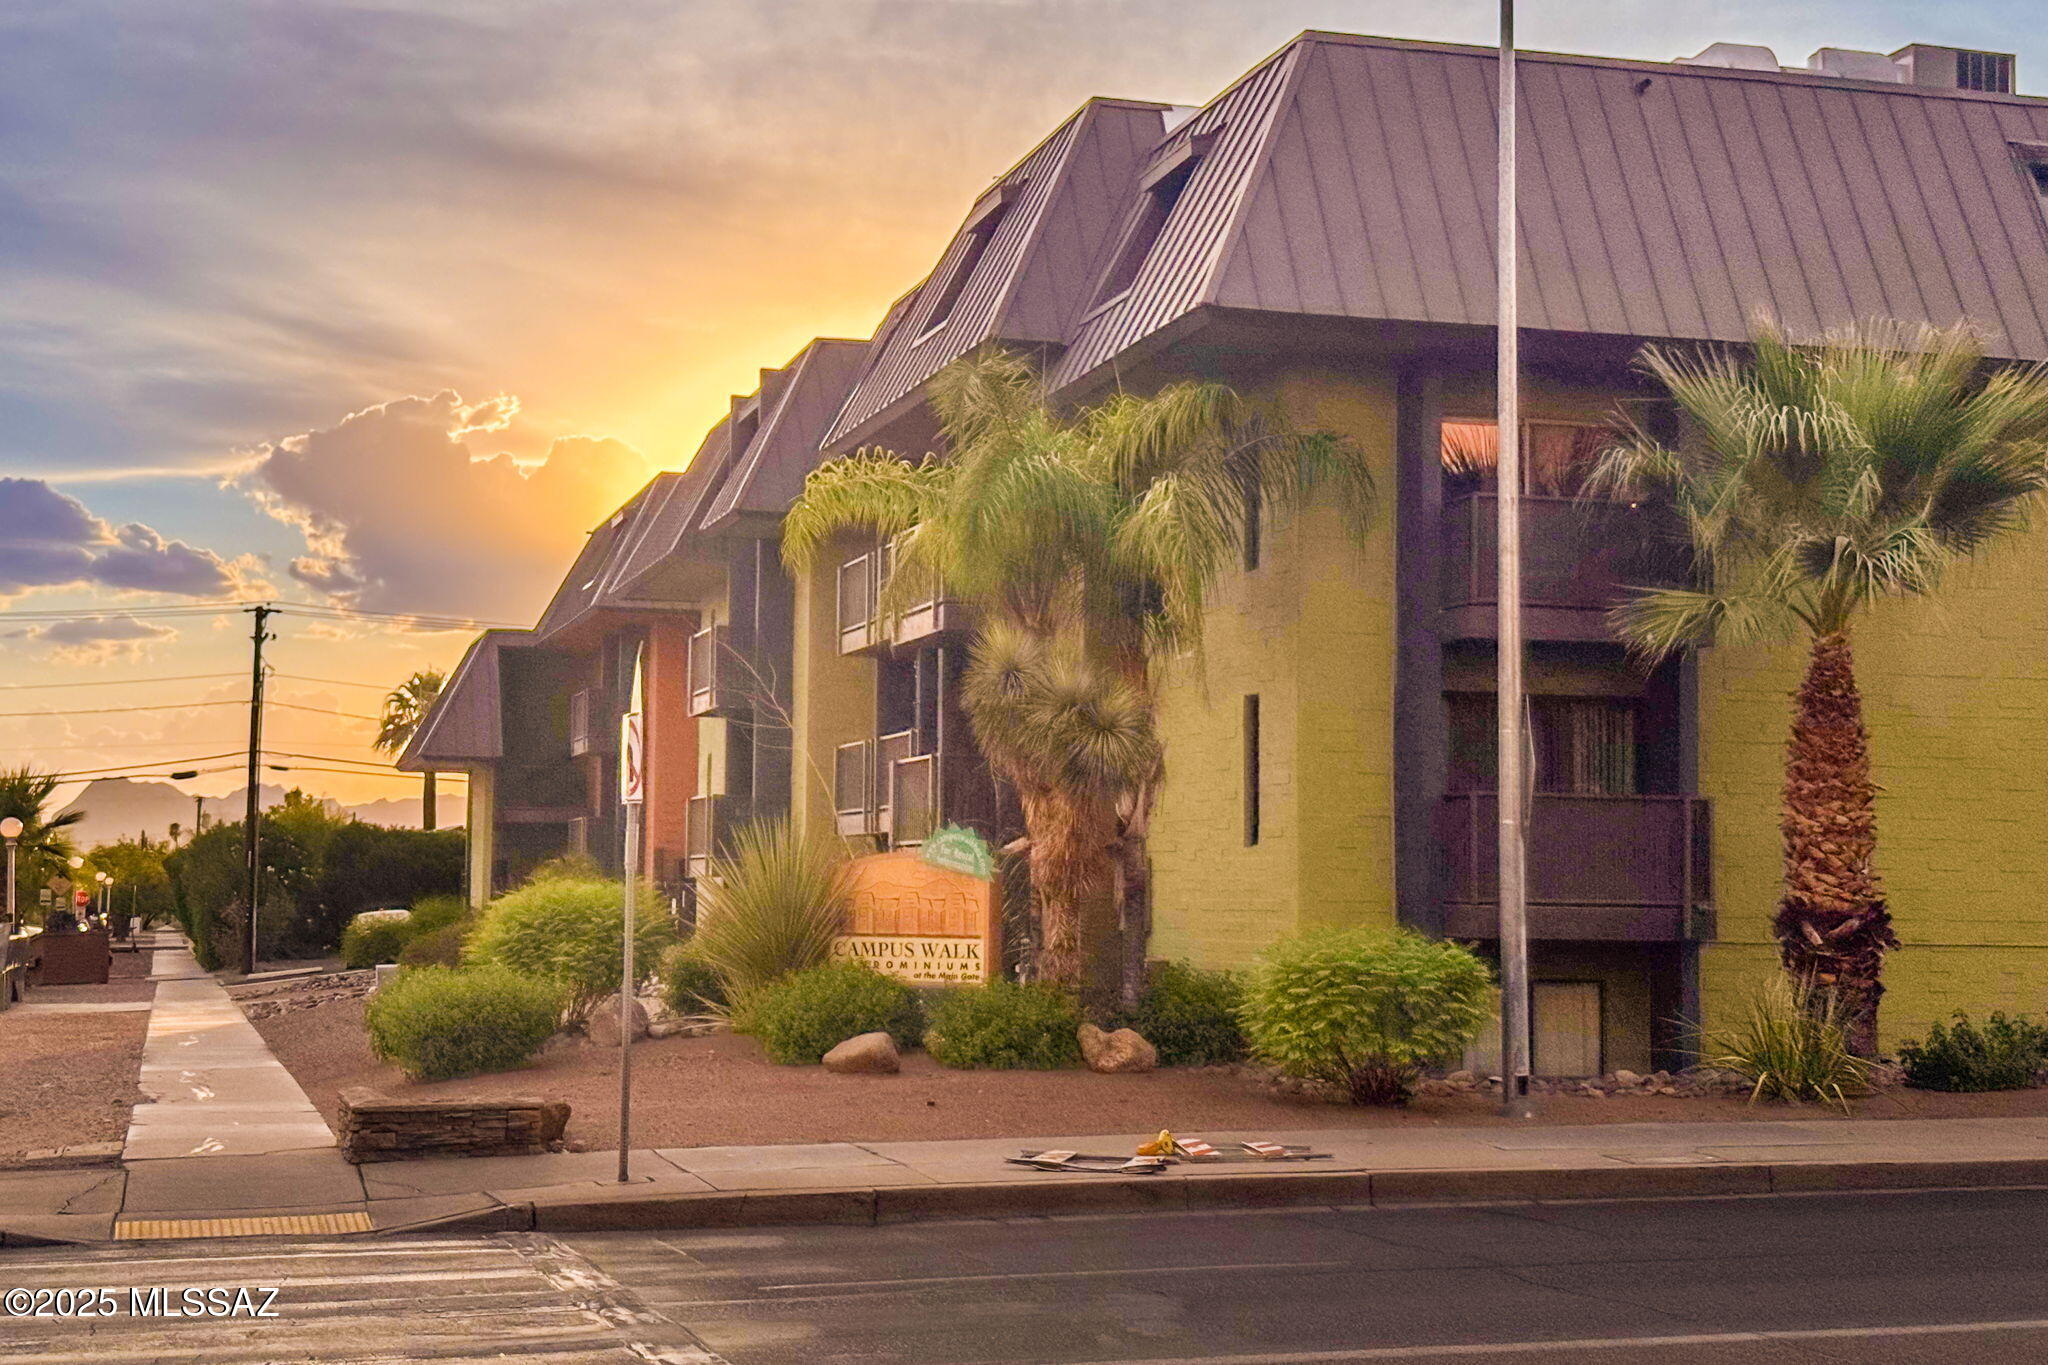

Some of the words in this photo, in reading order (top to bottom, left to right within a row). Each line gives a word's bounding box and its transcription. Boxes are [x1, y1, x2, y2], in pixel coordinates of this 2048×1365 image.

[834, 941, 915, 957] CAMPUS
[921, 943, 980, 959] WALK
[924, 971, 936, 979] the
[939, 972, 958, 980] Main
[961, 973, 980, 981] Gate
